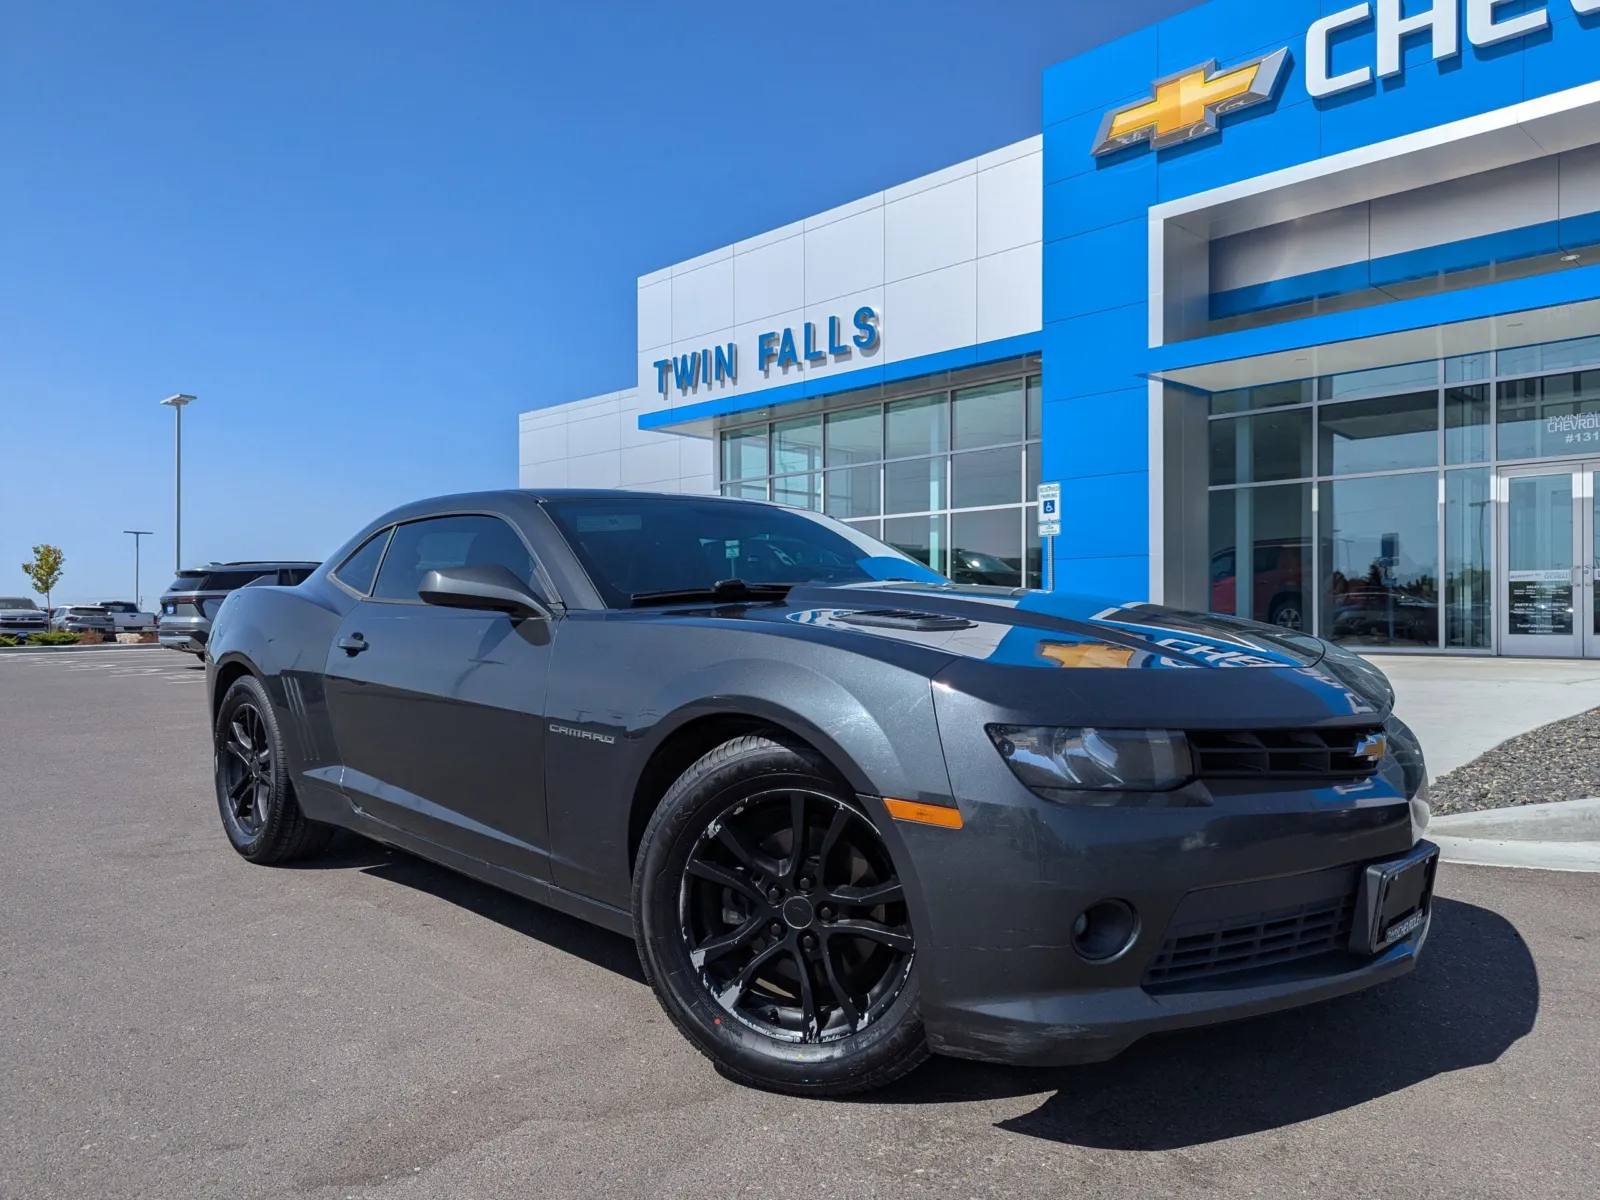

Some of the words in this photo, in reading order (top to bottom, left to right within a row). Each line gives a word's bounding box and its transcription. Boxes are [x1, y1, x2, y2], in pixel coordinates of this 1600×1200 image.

[653, 342, 738, 400] TWIN
[758, 306, 880, 374] FALLS
[549, 724, 616, 745] CAMARO
